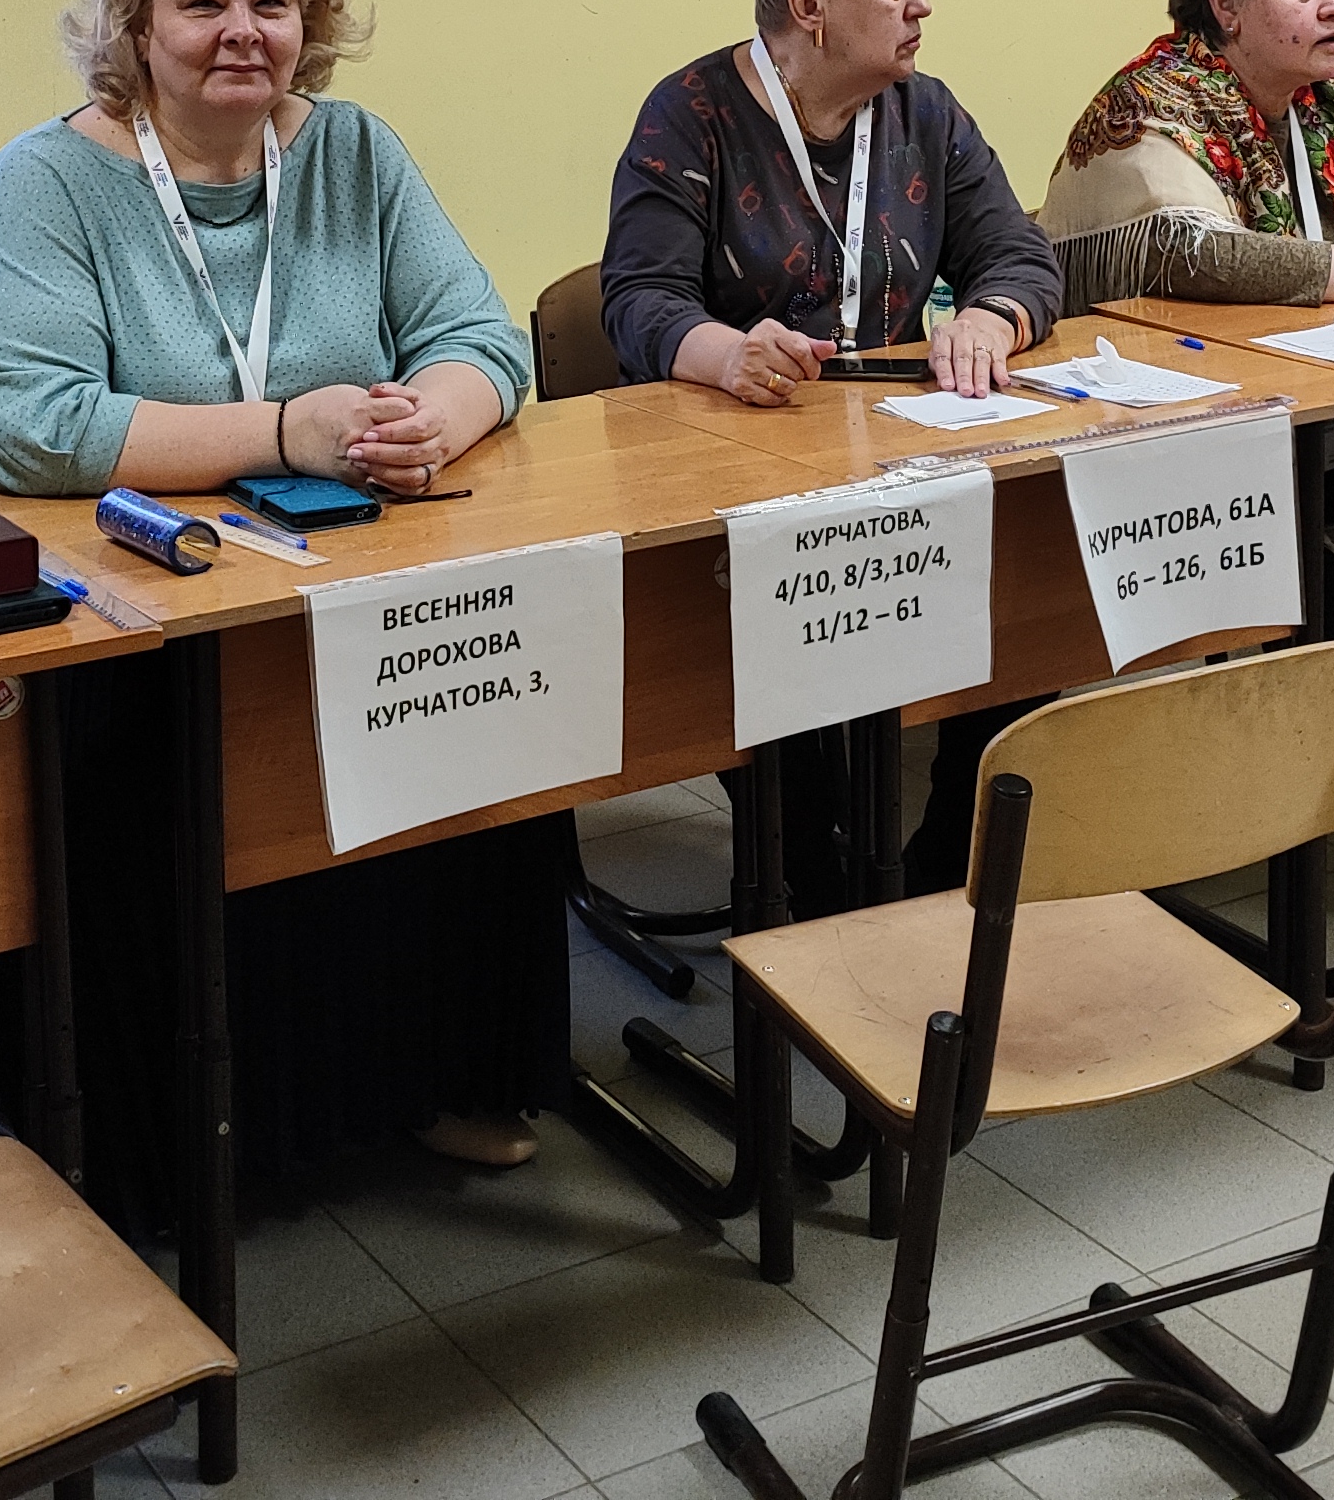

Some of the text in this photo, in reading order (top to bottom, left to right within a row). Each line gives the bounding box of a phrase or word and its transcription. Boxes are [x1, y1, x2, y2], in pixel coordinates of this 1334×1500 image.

[795, 508, 931, 552] КУРЧАТОВА,
[1087, 493, 1276, 559] КУРЧАТОВА, 61А
[775, 545, 952, 606] 4/10, 8/3,10/4,
[1116, 570, 1140, 601] 66
[1162, 554, 1207, 586] 126,
[1220, 542, 1265, 571] 61Б
[382, 584, 514, 631] ВЕСЕННЯЯ
[802, 608, 869, 645] 11/12
[896, 595, 923, 622] 61
[376, 629, 522, 687] ДОРОХОВА
[366, 669, 550, 732] КУРЧАТОВА, 3,
